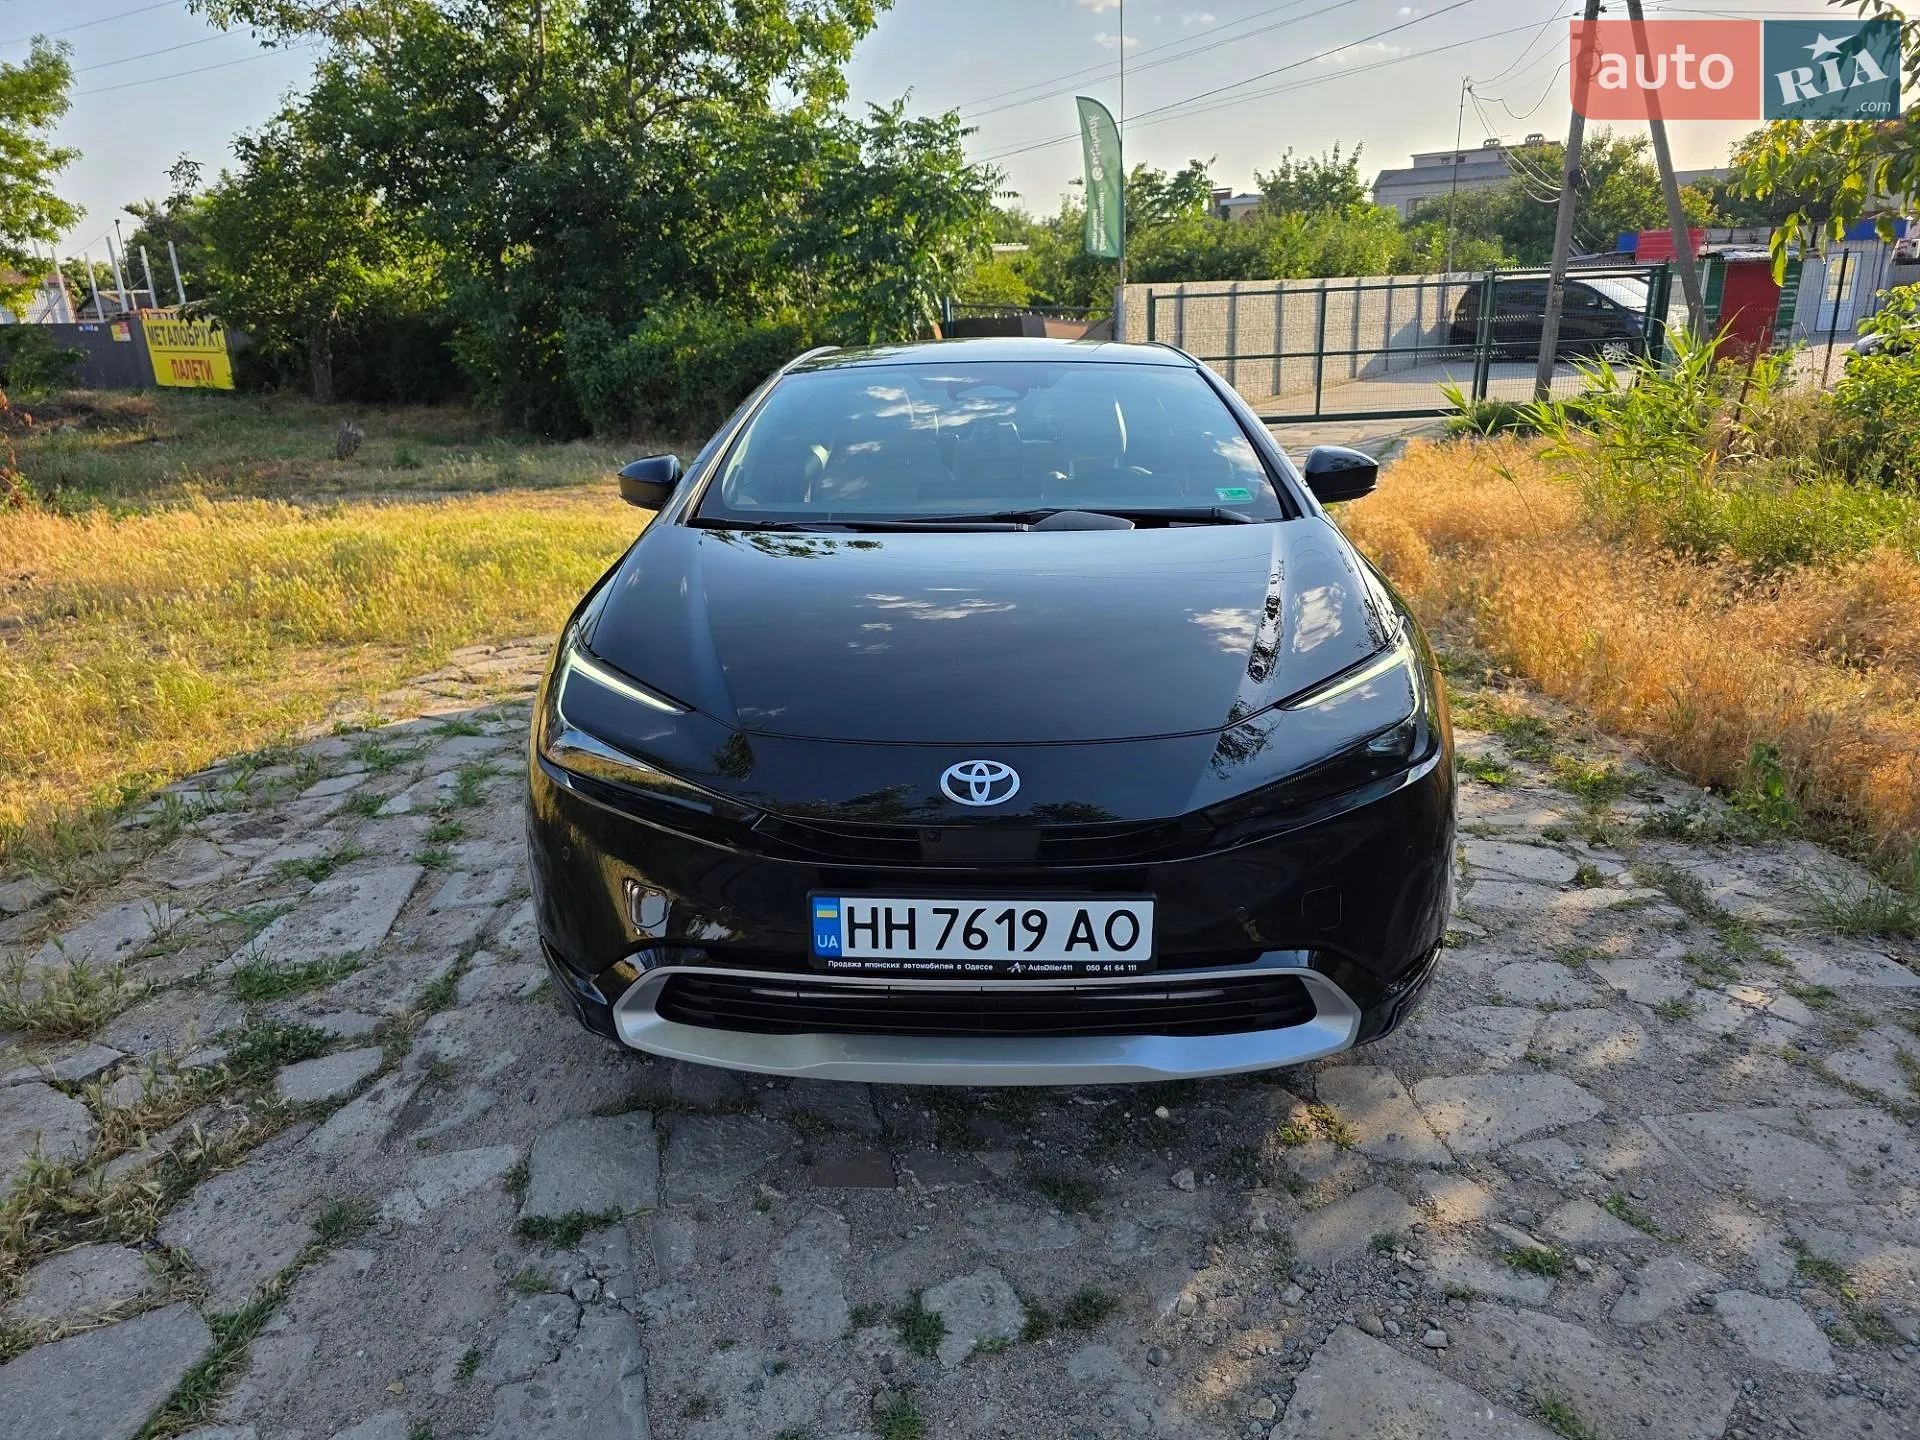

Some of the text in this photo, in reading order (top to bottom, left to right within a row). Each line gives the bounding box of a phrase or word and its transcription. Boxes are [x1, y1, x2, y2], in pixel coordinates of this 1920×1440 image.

[170, 359, 215, 381] ПАЛЕТИ
[932, 908, 1048, 952] 7619
[817, 934, 839, 949] UA
[827, 960, 862, 969] Продажа
[865, 961, 900, 970] японских
[903, 962, 954, 971] автомобилей
[964, 963, 993, 972] Одессе
[1086, 964, 1100, 972] 050
[1103, 964, 1112, 972] 41
[1127, 964, 1137, 972] 111
